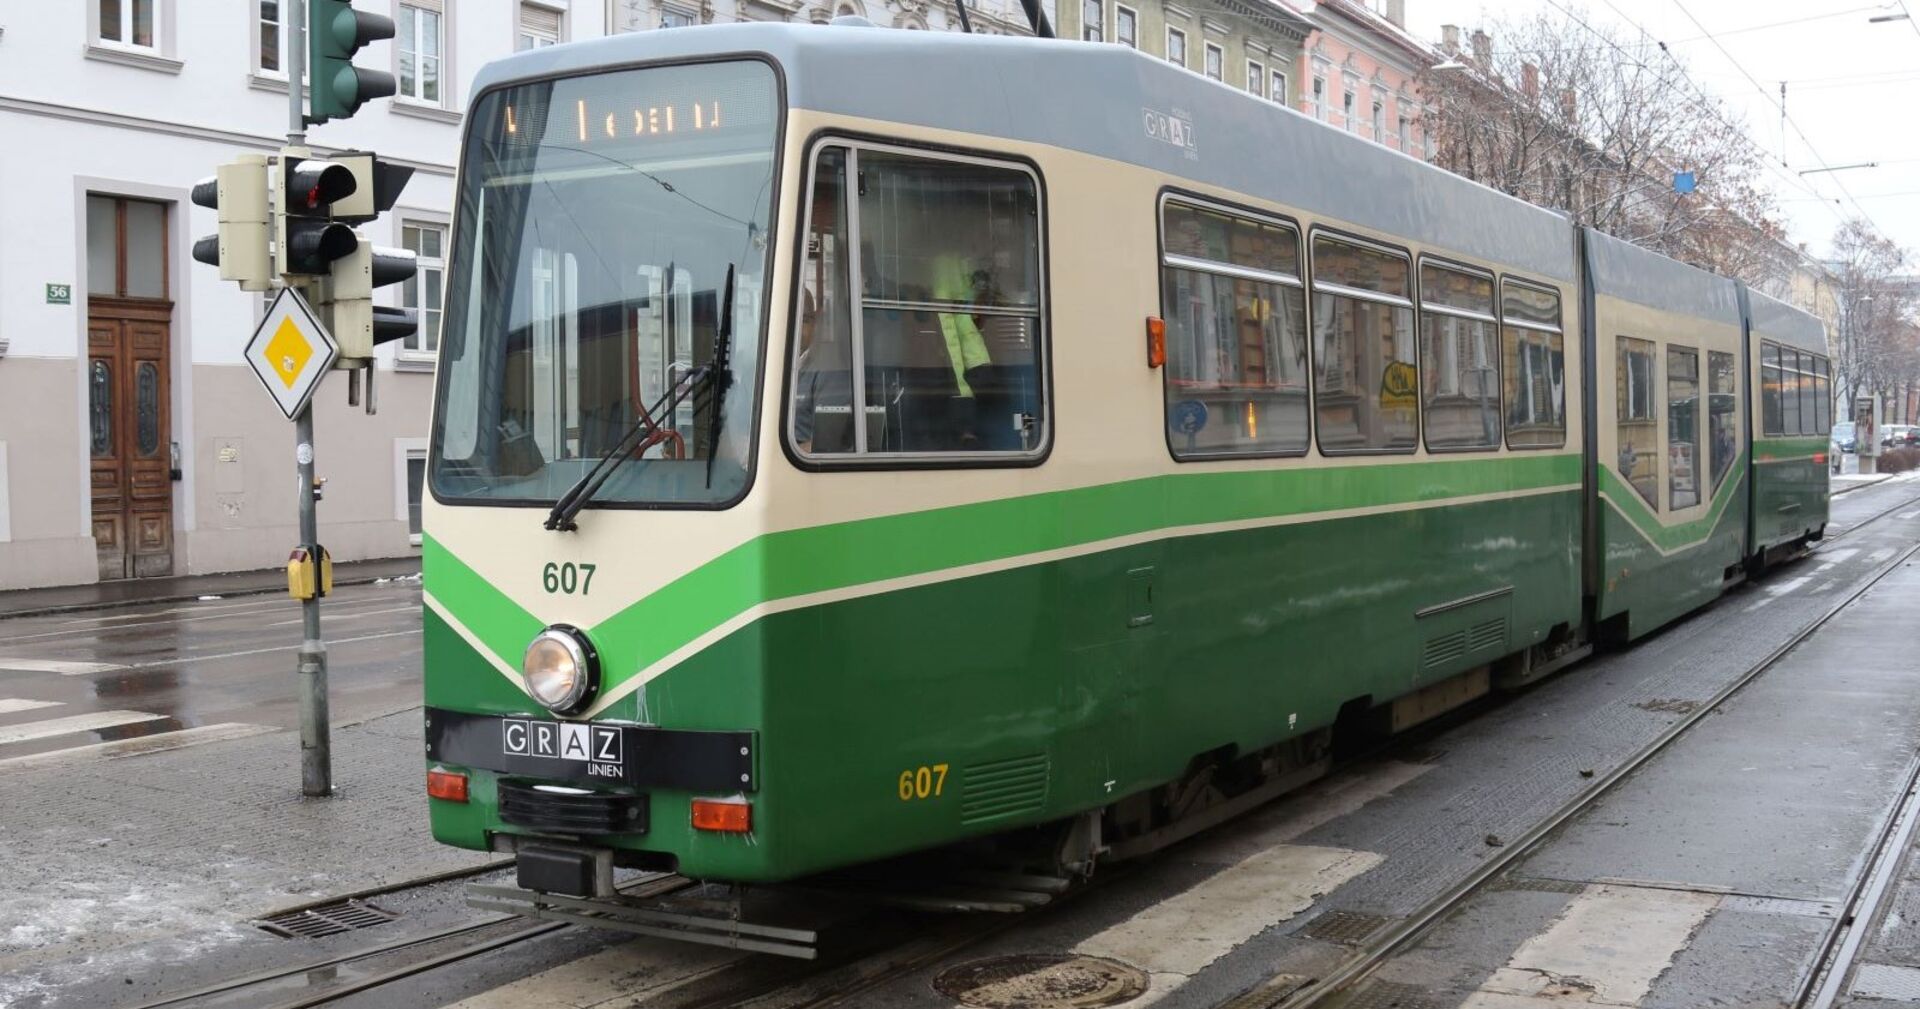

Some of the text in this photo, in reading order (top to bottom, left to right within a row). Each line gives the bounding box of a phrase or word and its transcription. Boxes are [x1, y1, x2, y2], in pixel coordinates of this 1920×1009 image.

[1144, 110, 1196, 149] GRAZ
[50, 286, 67, 297] 56
[543, 562, 596, 595] 607
[504, 721, 620, 762] GRAZ
[588, 763, 623, 777] LINIEN
[899, 763, 949, 800] 607
